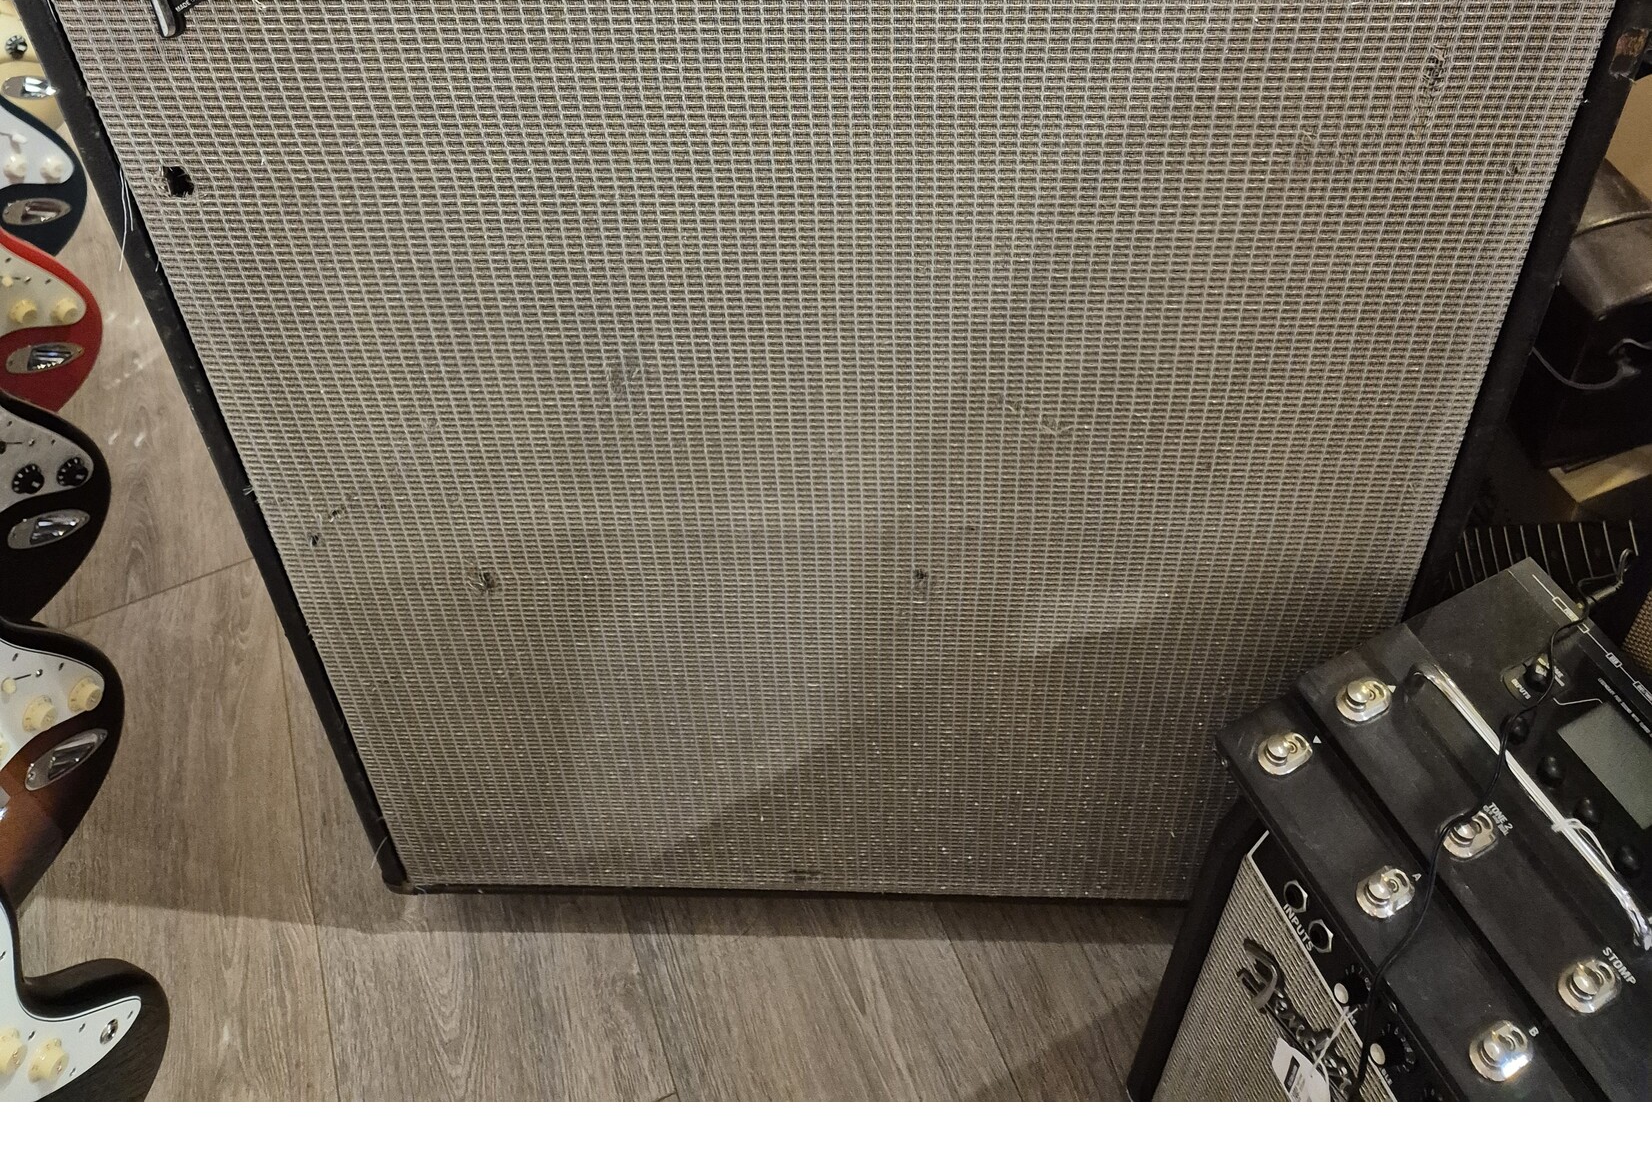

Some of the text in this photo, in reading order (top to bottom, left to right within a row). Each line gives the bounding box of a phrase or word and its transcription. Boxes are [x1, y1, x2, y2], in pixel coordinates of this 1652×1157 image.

[175, 0, 191, 12] MADE
[1511, 678, 1531, 700] INPUTS
[1489, 802, 1513, 831] TONE 2
[1412, 873, 1422, 882] A
[1283, 904, 1314, 952] INPUTS
[1602, 947, 1636, 984] STOMP
[1529, 1026, 1539, 1037] B
